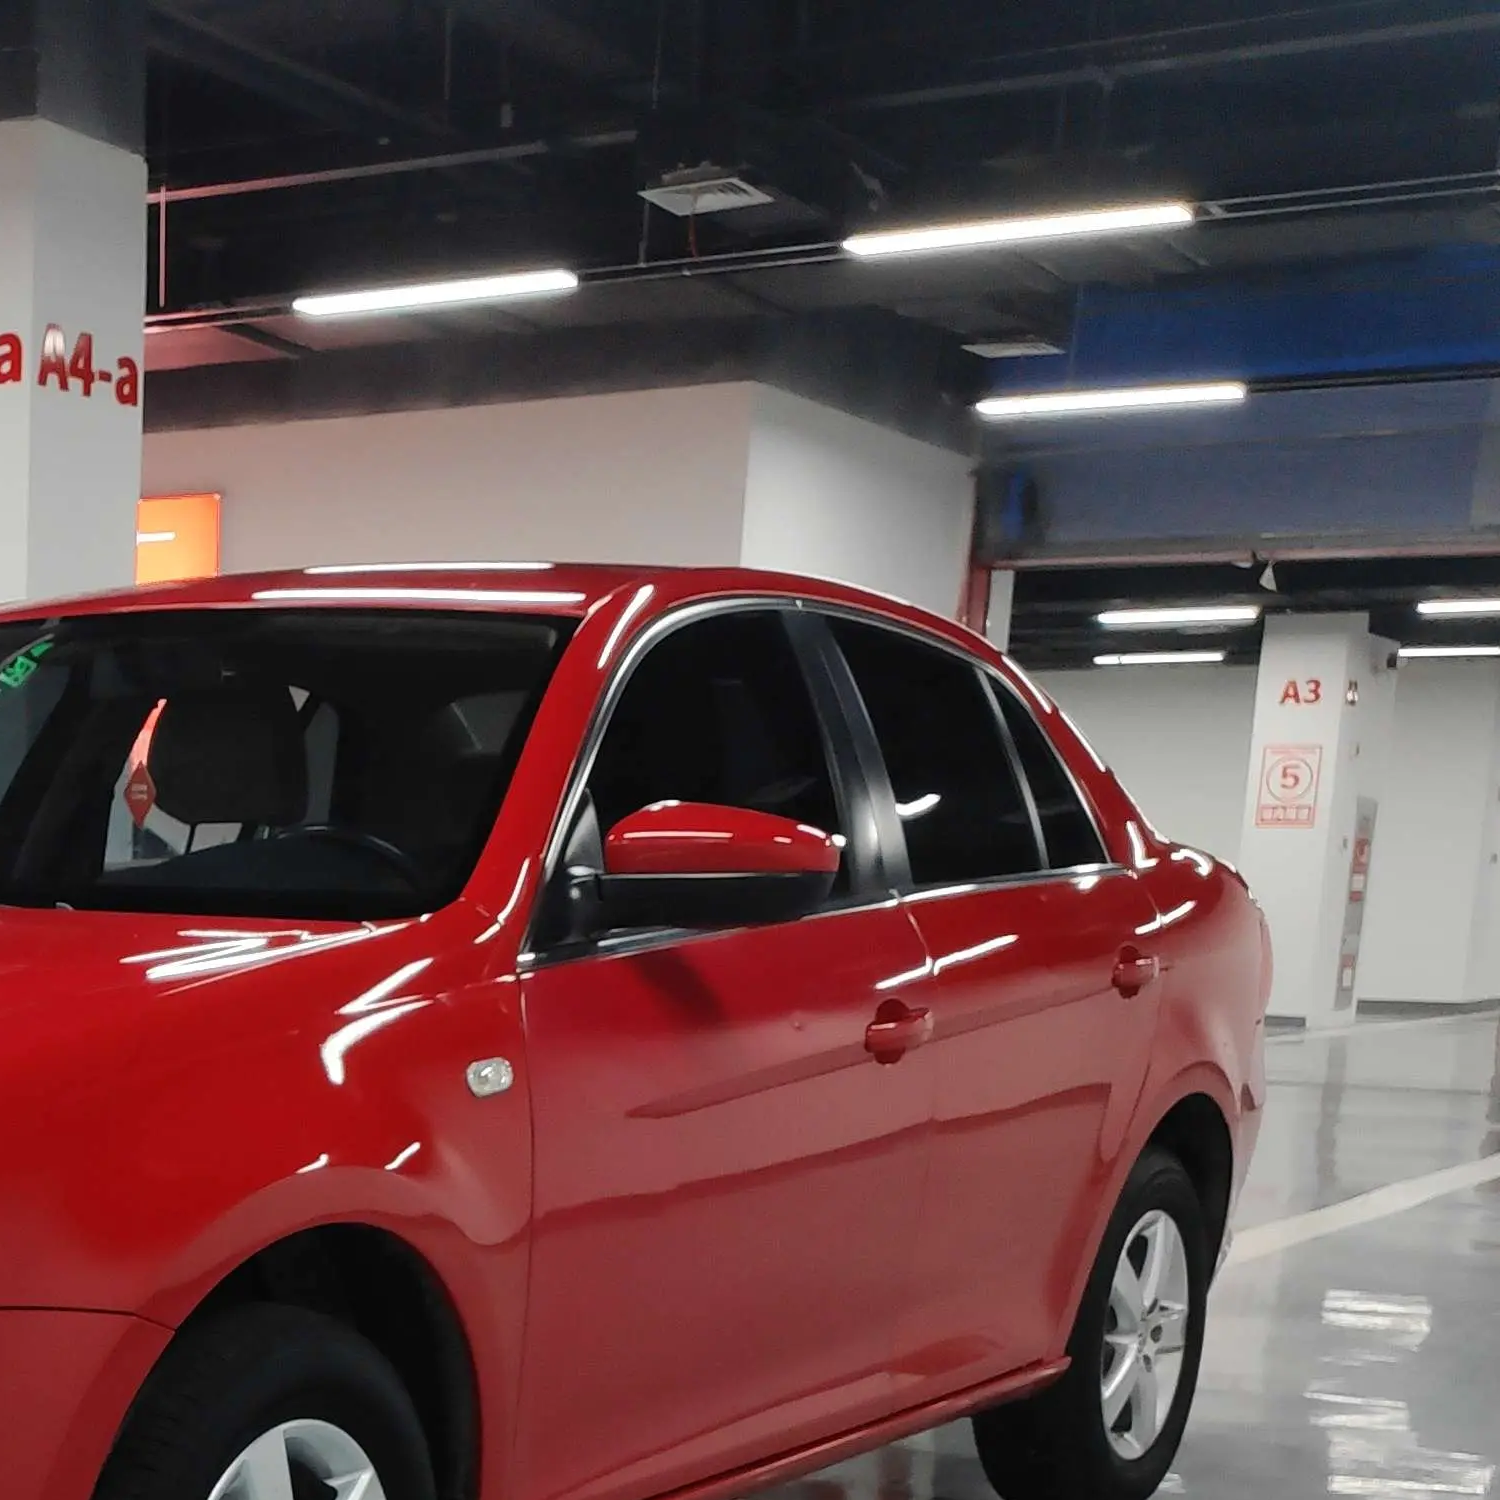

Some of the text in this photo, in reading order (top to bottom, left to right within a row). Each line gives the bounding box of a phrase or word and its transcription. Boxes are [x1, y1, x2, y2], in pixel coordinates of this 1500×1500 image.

[38, 323, 138, 407] A4-a
[1279, 679, 1322, 704] A3
[1279, 765, 1301, 789] 5
